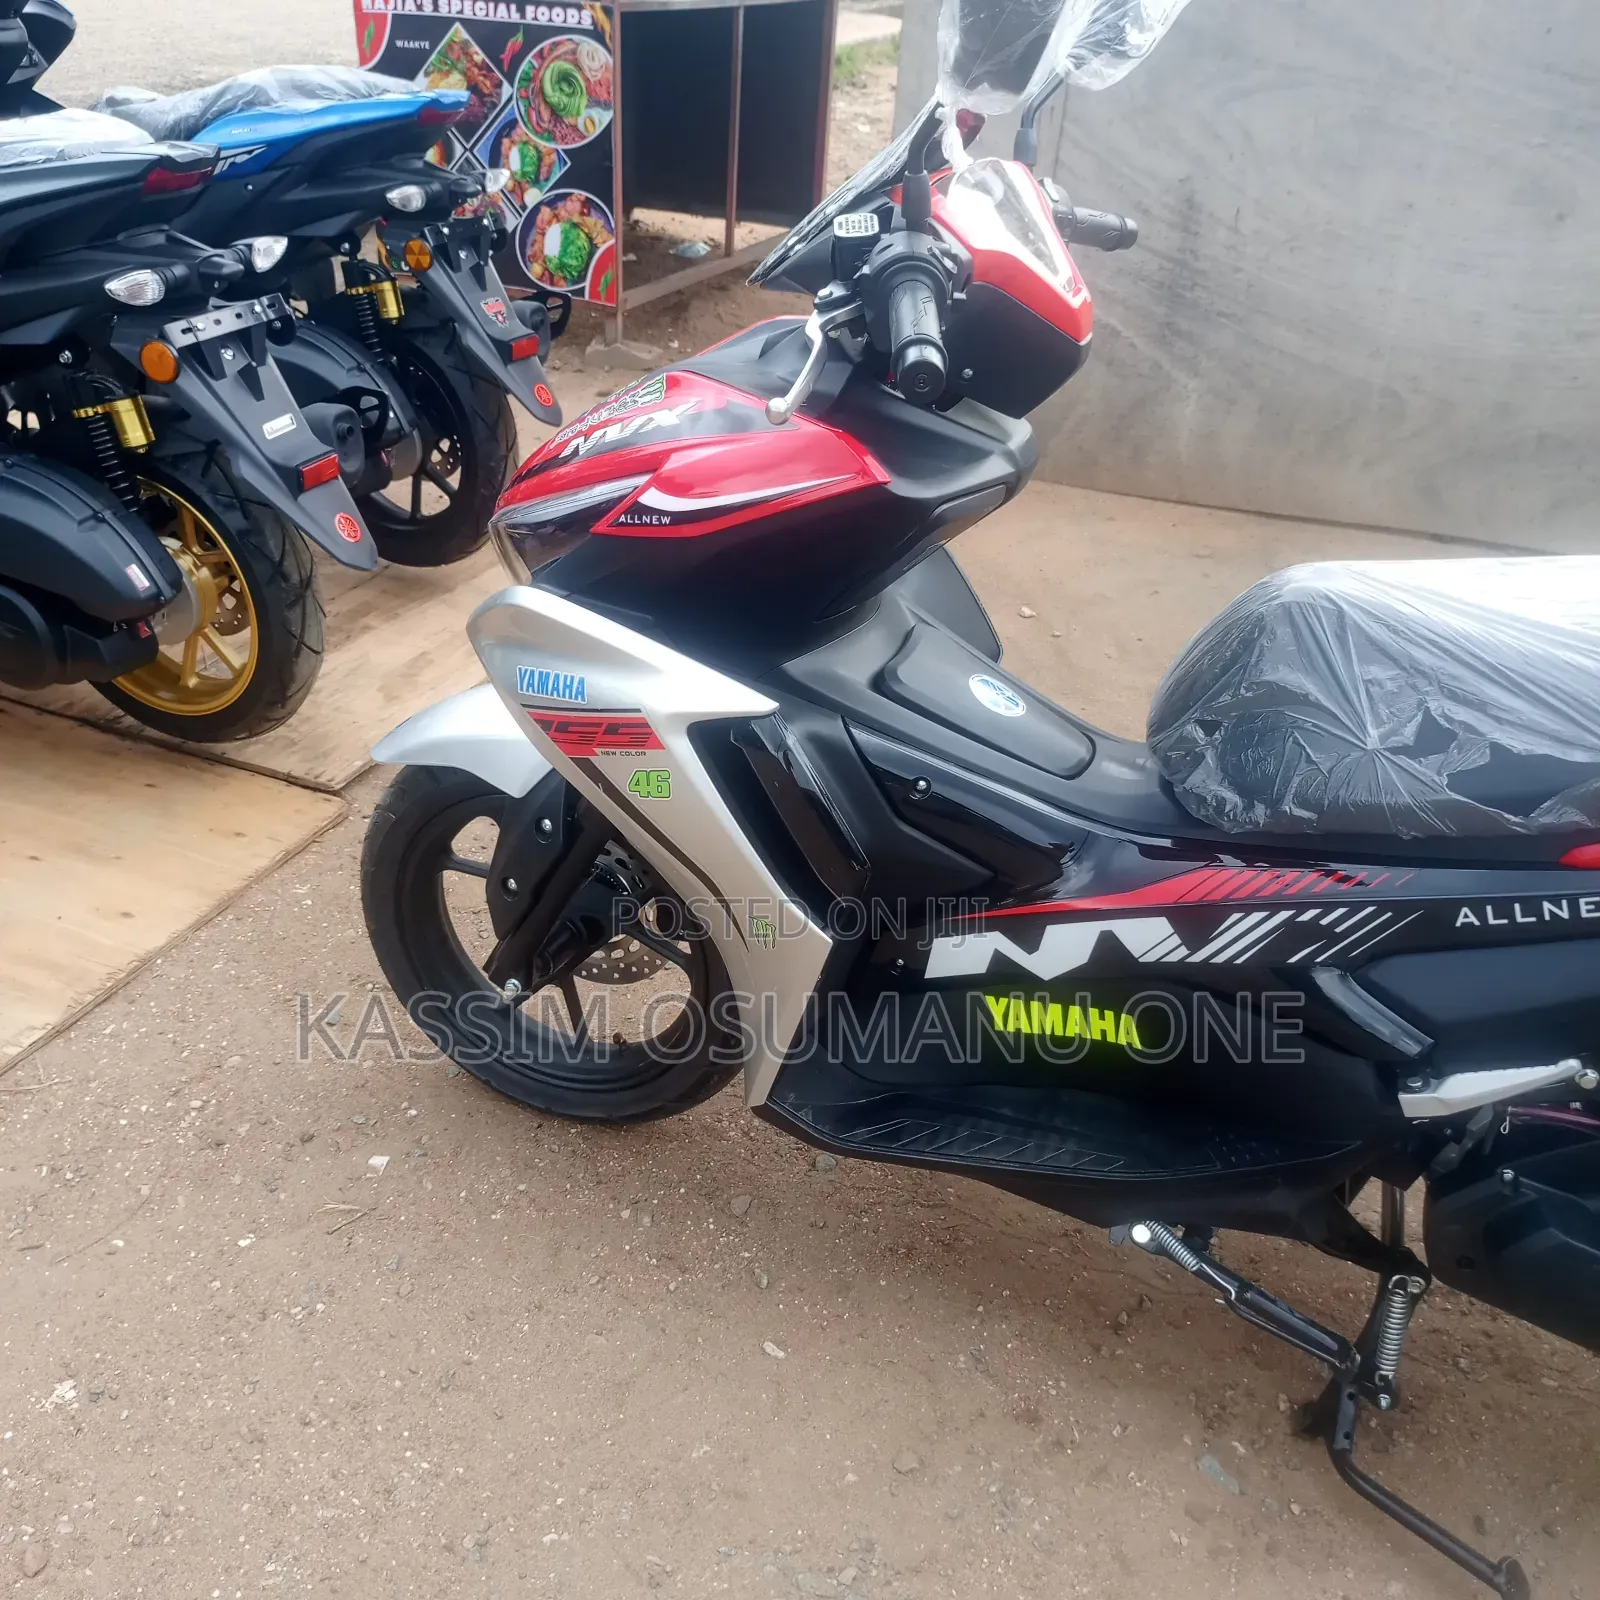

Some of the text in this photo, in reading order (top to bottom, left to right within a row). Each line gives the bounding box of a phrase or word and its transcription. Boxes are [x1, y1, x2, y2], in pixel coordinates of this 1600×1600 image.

[438, 0, 521, 19] SPECIAL
[525, 4, 593, 26] FOODS
[395, 39, 430, 50] WAAKYE
[618, 513, 671, 525] ALLNEW
[517, 665, 587, 704] YAMAHA
[627, 768, 672, 800] 46
[985, 995, 1142, 1049] YAMAHA
